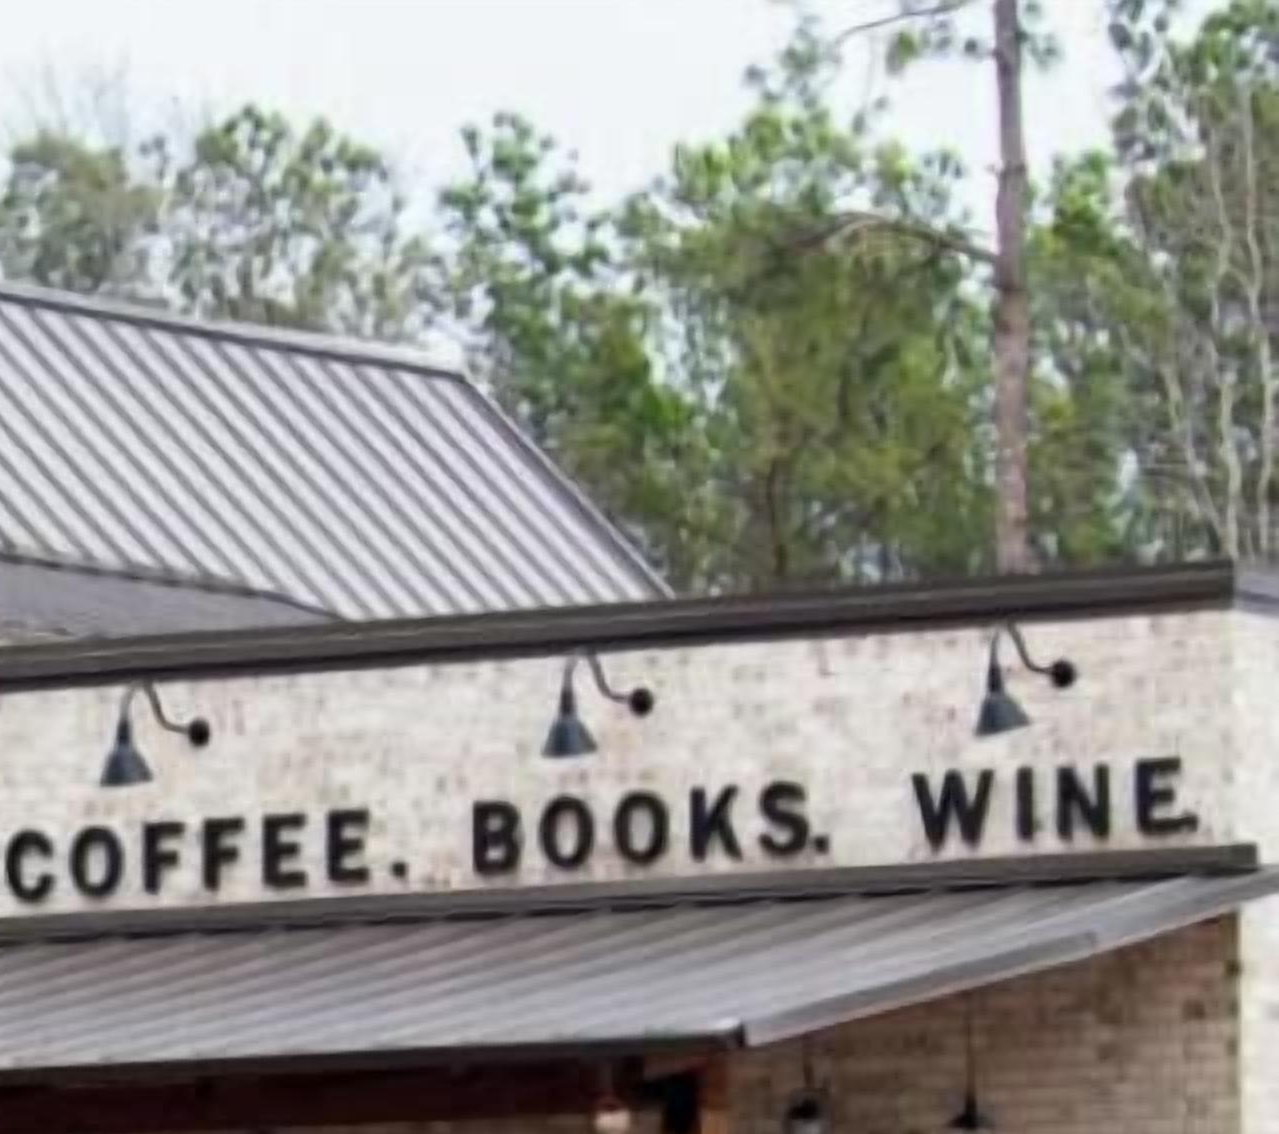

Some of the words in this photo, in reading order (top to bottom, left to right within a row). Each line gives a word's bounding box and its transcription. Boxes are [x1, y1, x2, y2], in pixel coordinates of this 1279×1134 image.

[4, 807, 409, 905] COFFEE.
[471, 780, 830, 876] BOOKS.
[910, 756, 1199, 852] WINE.
